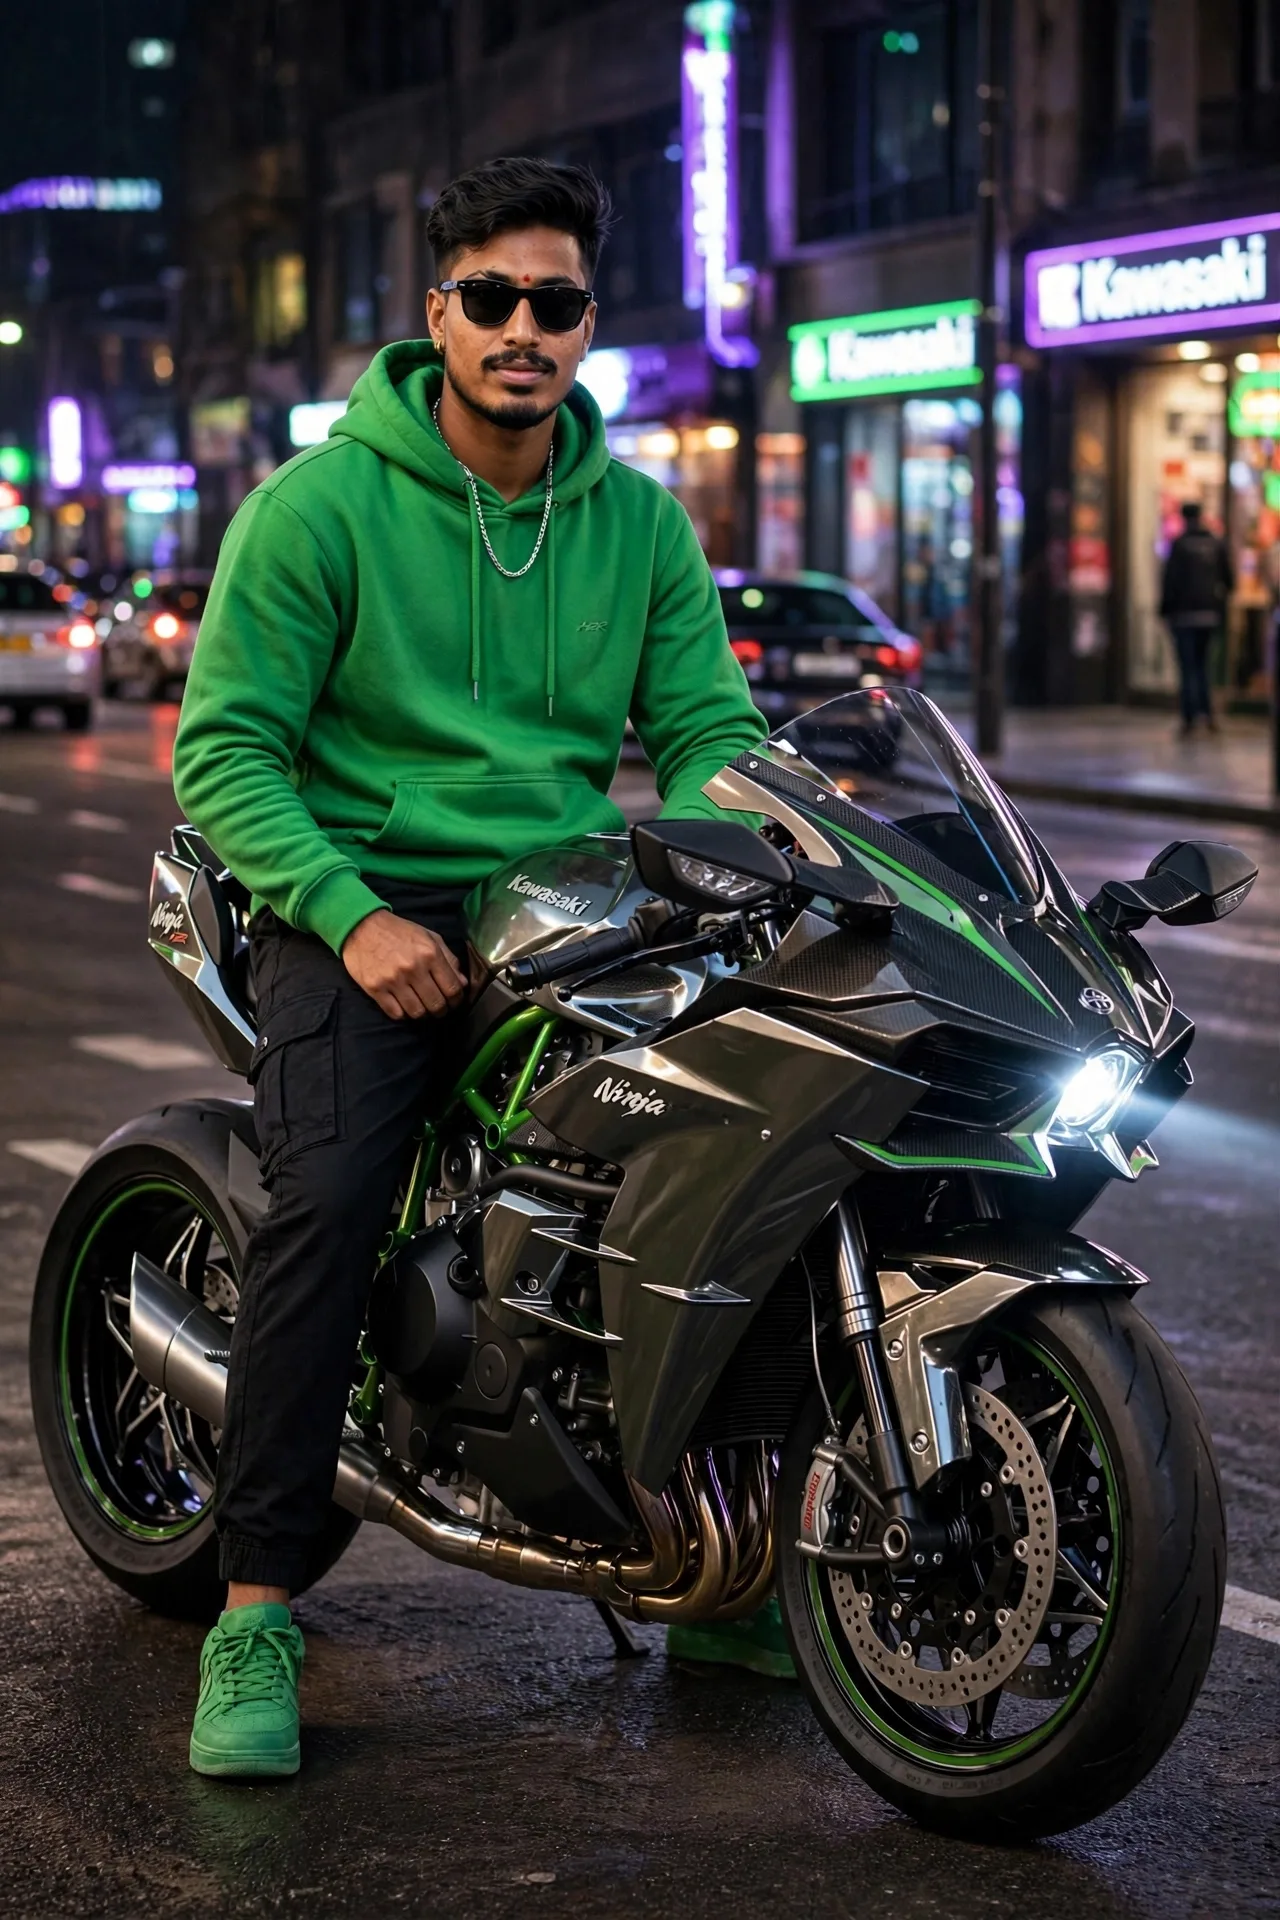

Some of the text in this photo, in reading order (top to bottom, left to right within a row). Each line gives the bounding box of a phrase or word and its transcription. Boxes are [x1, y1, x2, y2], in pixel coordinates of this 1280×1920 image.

[1082, 233, 1265, 322] Kawasaki
[828, 314, 975, 382] Kawasaki
[507, 874, 592, 916] Kawasaki
[150, 901, 184, 939] Ninja
[593, 1077, 666, 1117] Ninja
